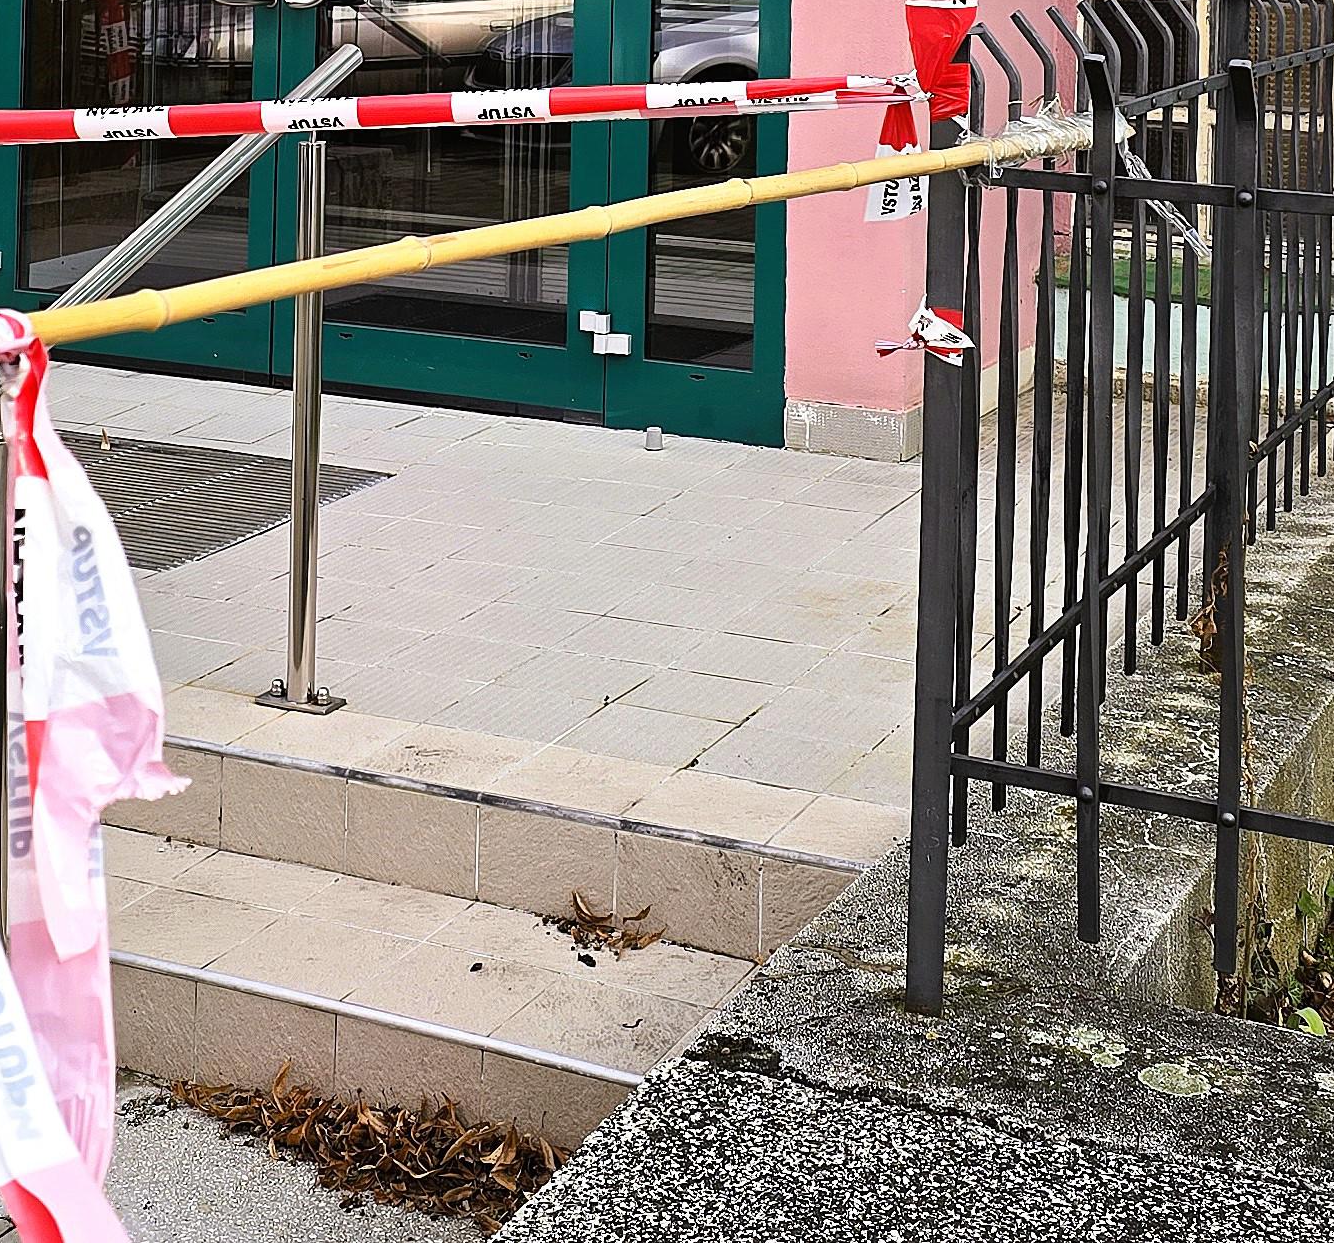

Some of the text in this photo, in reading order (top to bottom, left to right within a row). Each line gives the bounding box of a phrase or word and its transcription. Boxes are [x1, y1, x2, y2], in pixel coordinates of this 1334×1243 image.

[477, 107, 535, 119] VSTUP
[288, 116, 345, 130] VSTUP
[102, 128, 159, 139] VSTUP
[880, 178, 899, 216] VSTU
